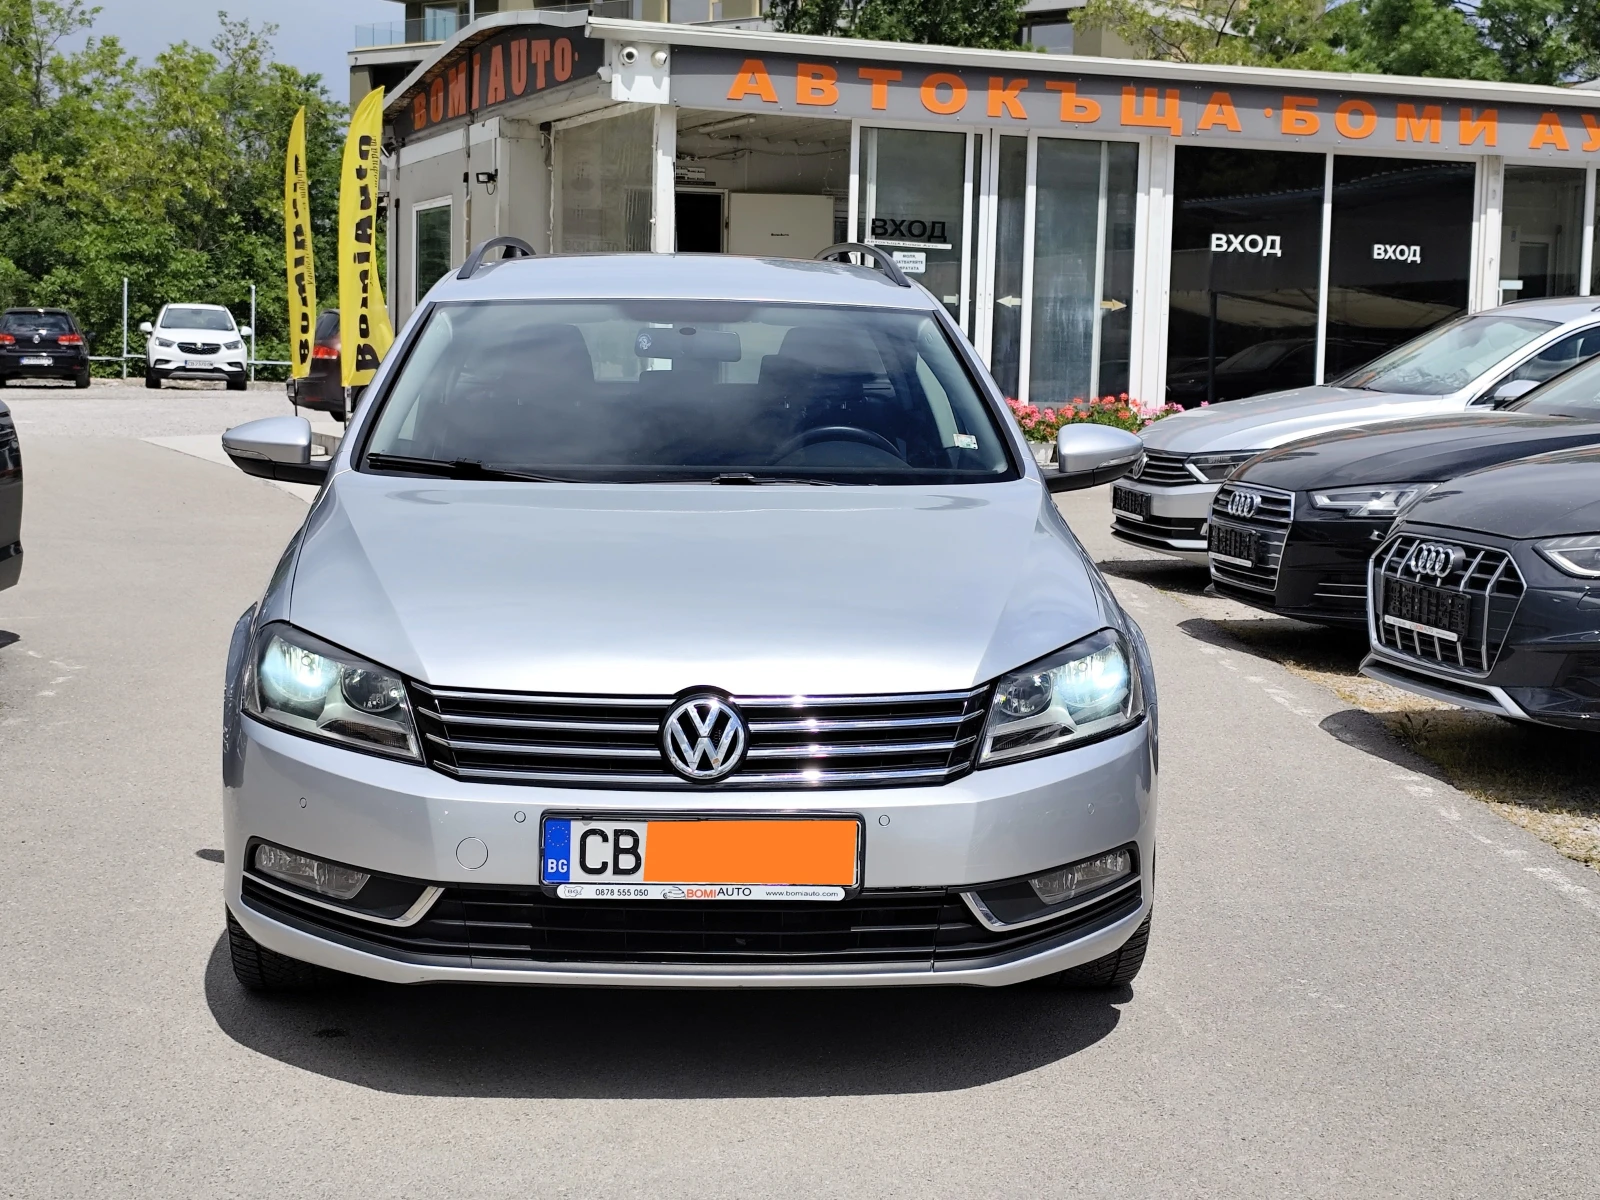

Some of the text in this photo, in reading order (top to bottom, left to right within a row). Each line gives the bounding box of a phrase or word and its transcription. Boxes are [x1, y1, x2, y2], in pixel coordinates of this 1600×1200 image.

[726, 58, 1242, 137] АВТОКЪЩА
[1280, 95, 1499, 147] БОМИ
[871, 218, 948, 243] ВХОД
[1210, 233, 1282, 257] ВХОД
[1372, 243, 1422, 264] ВХОД
[547, 828, 642, 876] BG CB
[595, 888, 615, 897] 0878
[617, 888, 632, 897] 555
[633, 889, 649, 897] 050
[765, 889, 839, 898] www.bomiauto.com
